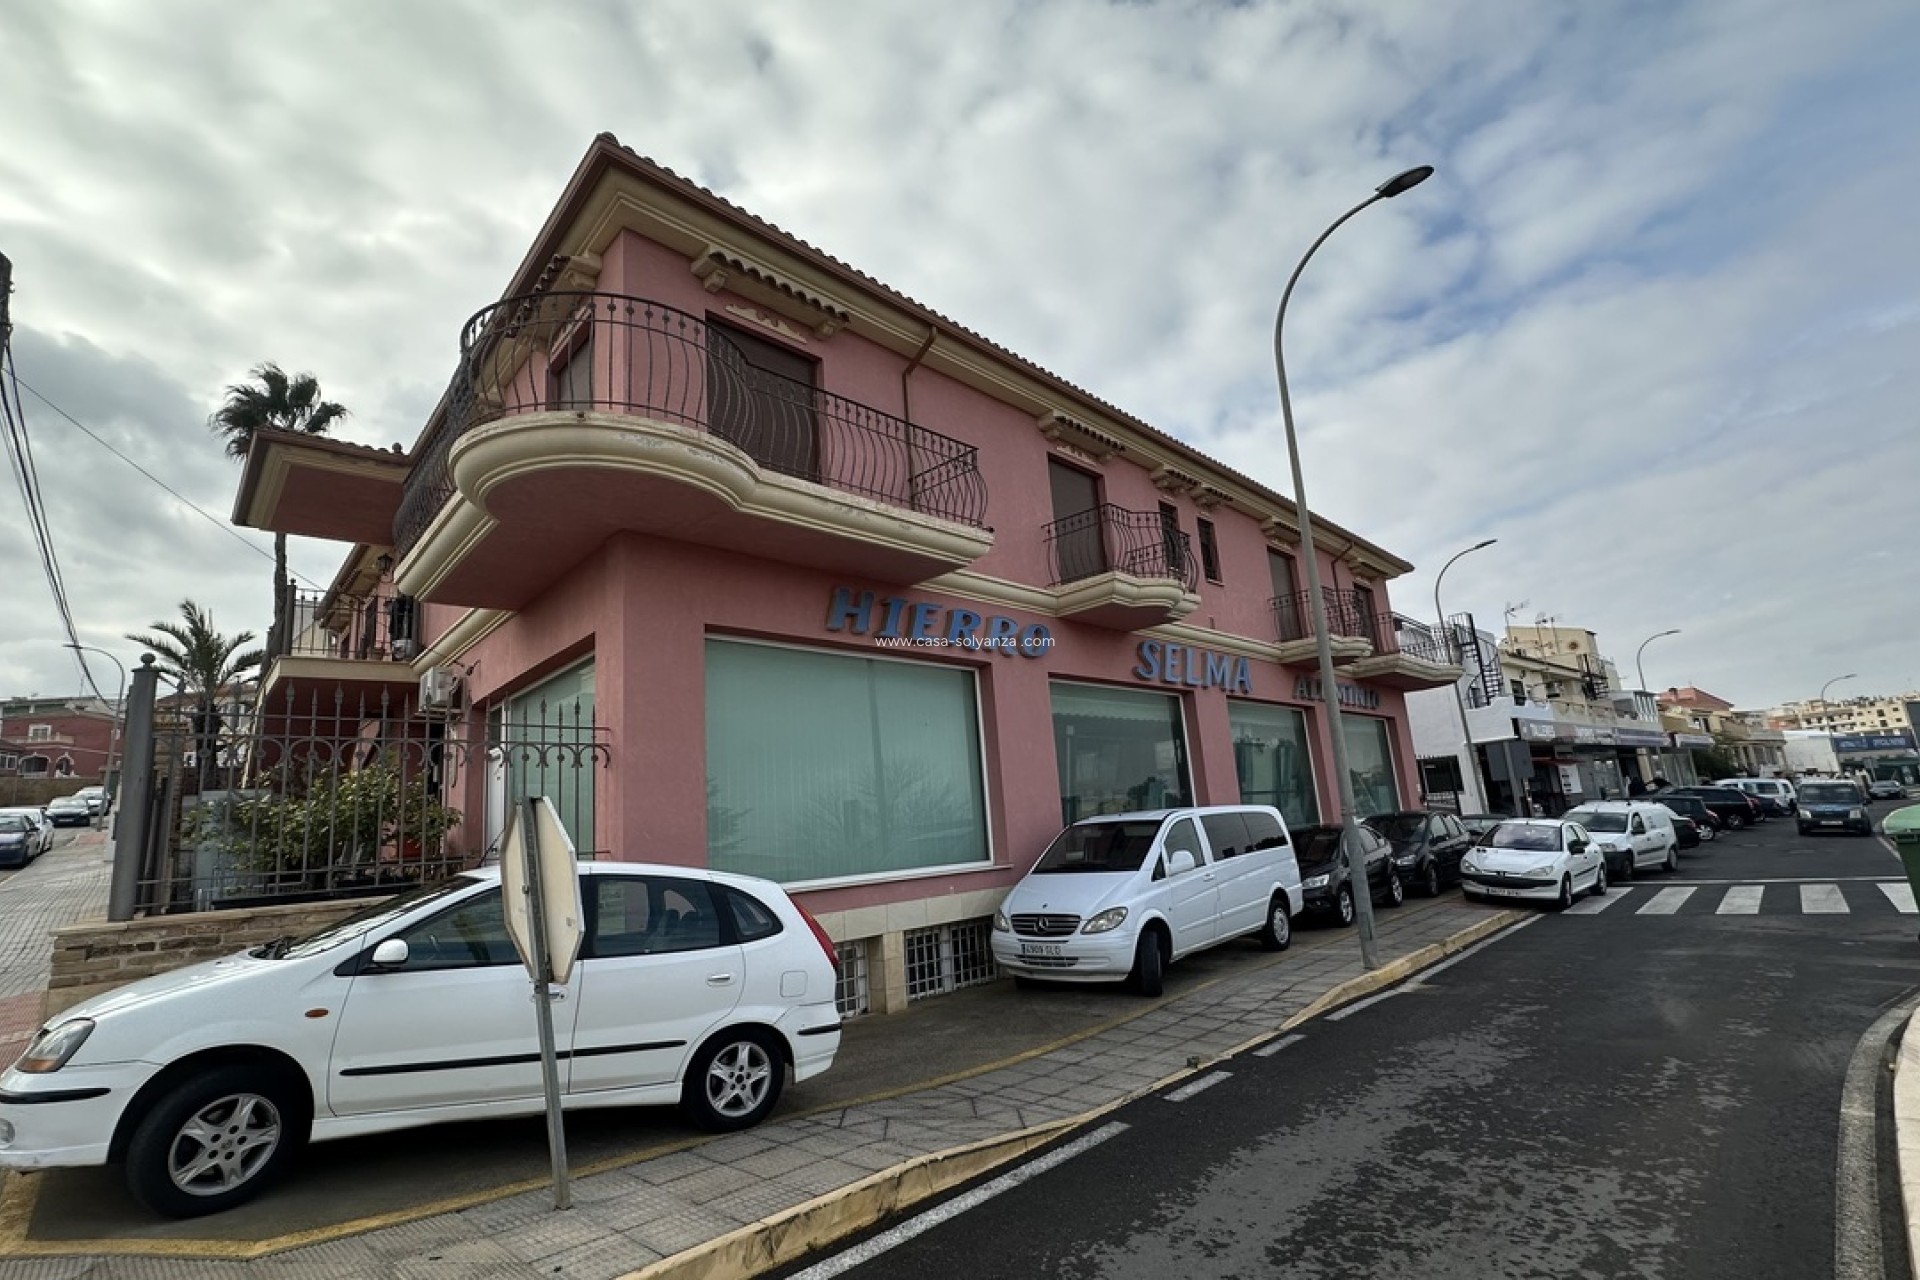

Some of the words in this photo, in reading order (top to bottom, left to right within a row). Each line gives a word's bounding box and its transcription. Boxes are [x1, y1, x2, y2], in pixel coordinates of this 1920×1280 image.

[826, 586, 1052, 659] HIERRO
[1135, 640, 1254, 693] SELMA
[1292, 674, 1381, 710] ALMINIO
